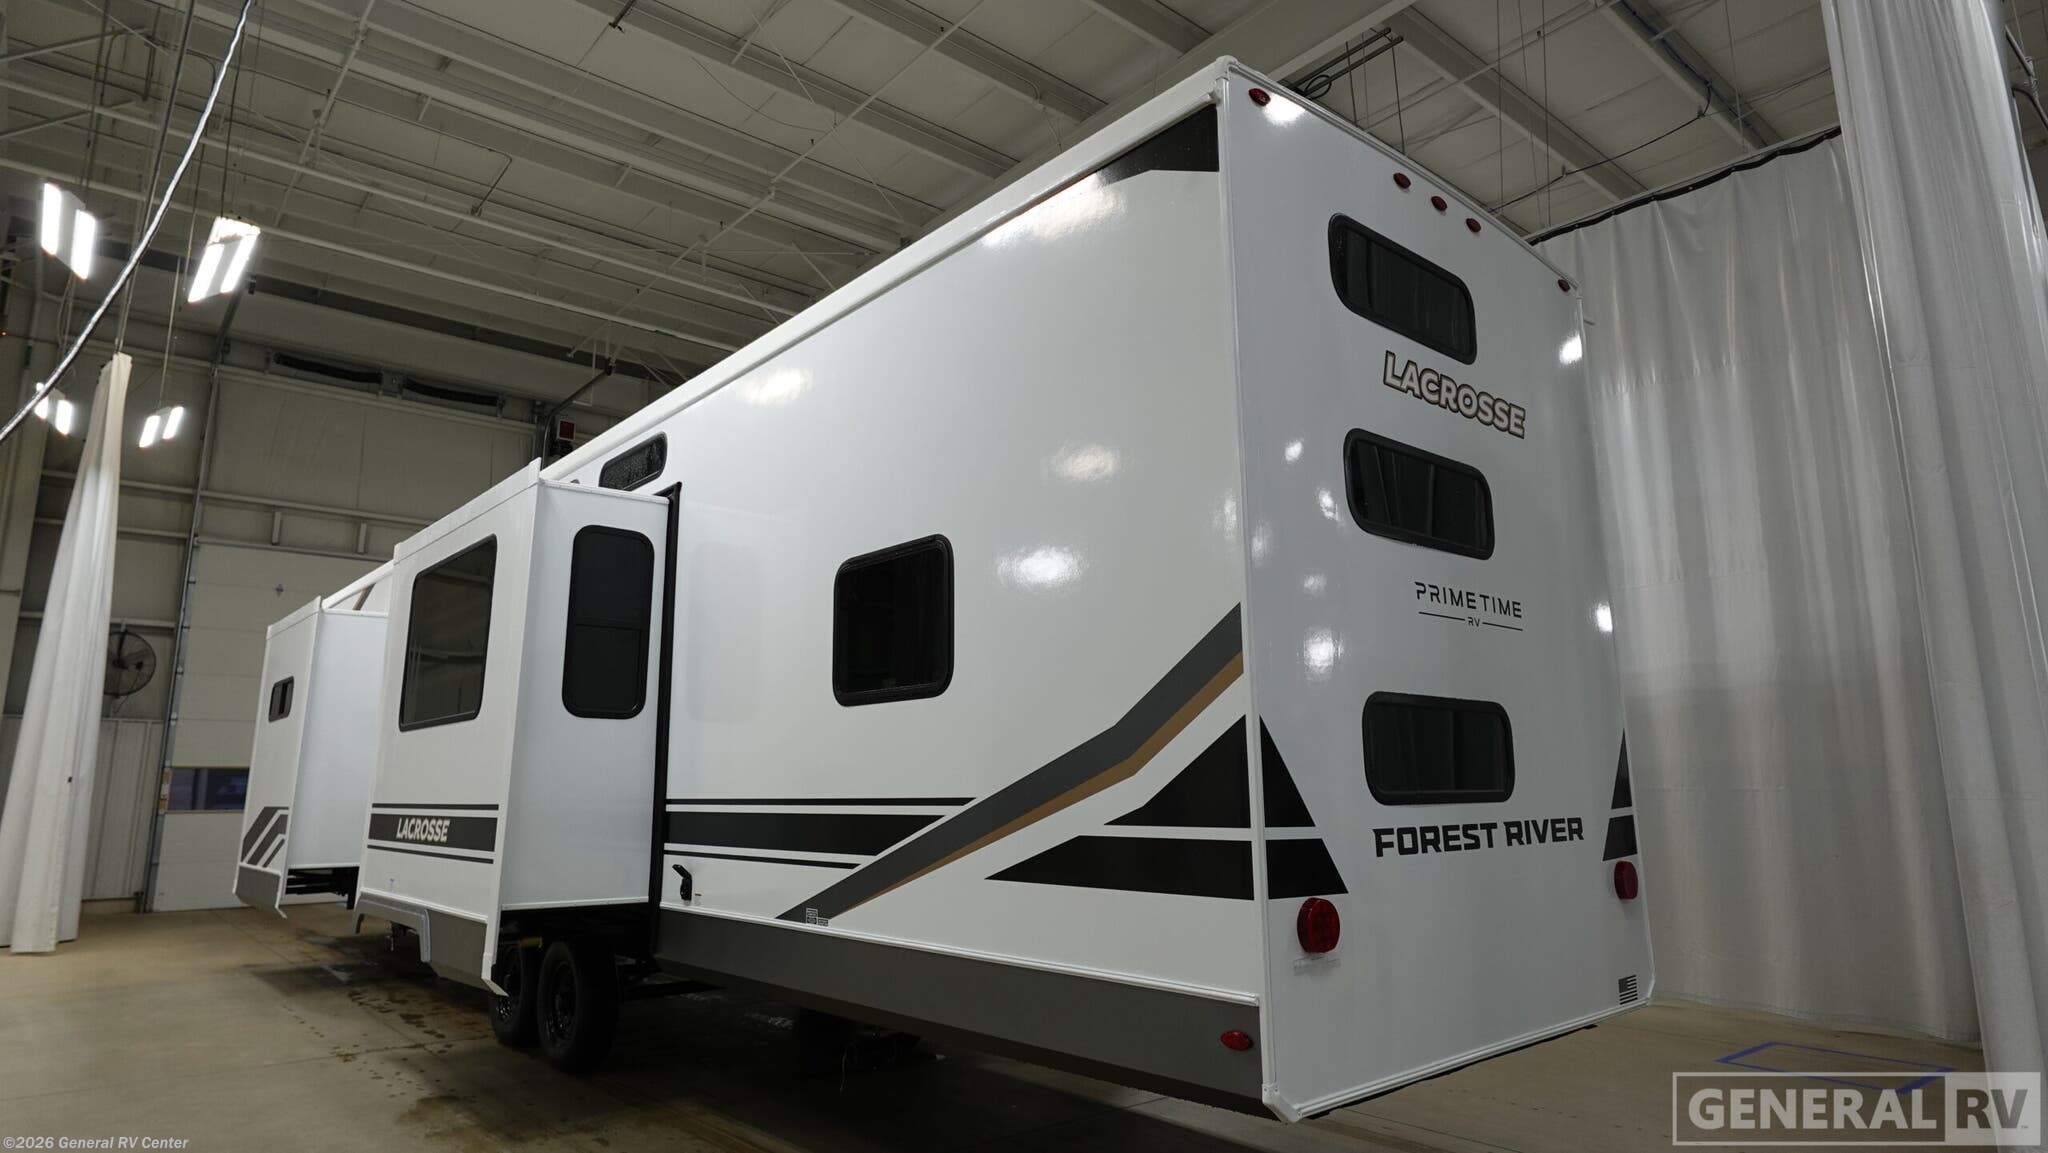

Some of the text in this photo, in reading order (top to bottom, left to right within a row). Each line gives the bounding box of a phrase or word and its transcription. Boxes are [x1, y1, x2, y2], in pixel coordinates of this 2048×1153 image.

[1383, 350, 1525, 439] LACROSSE
[1468, 616, 1480, 627] RV
[396, 817, 450, 842] LACROSSE
[1372, 817, 1584, 857] FOREST RIVER
